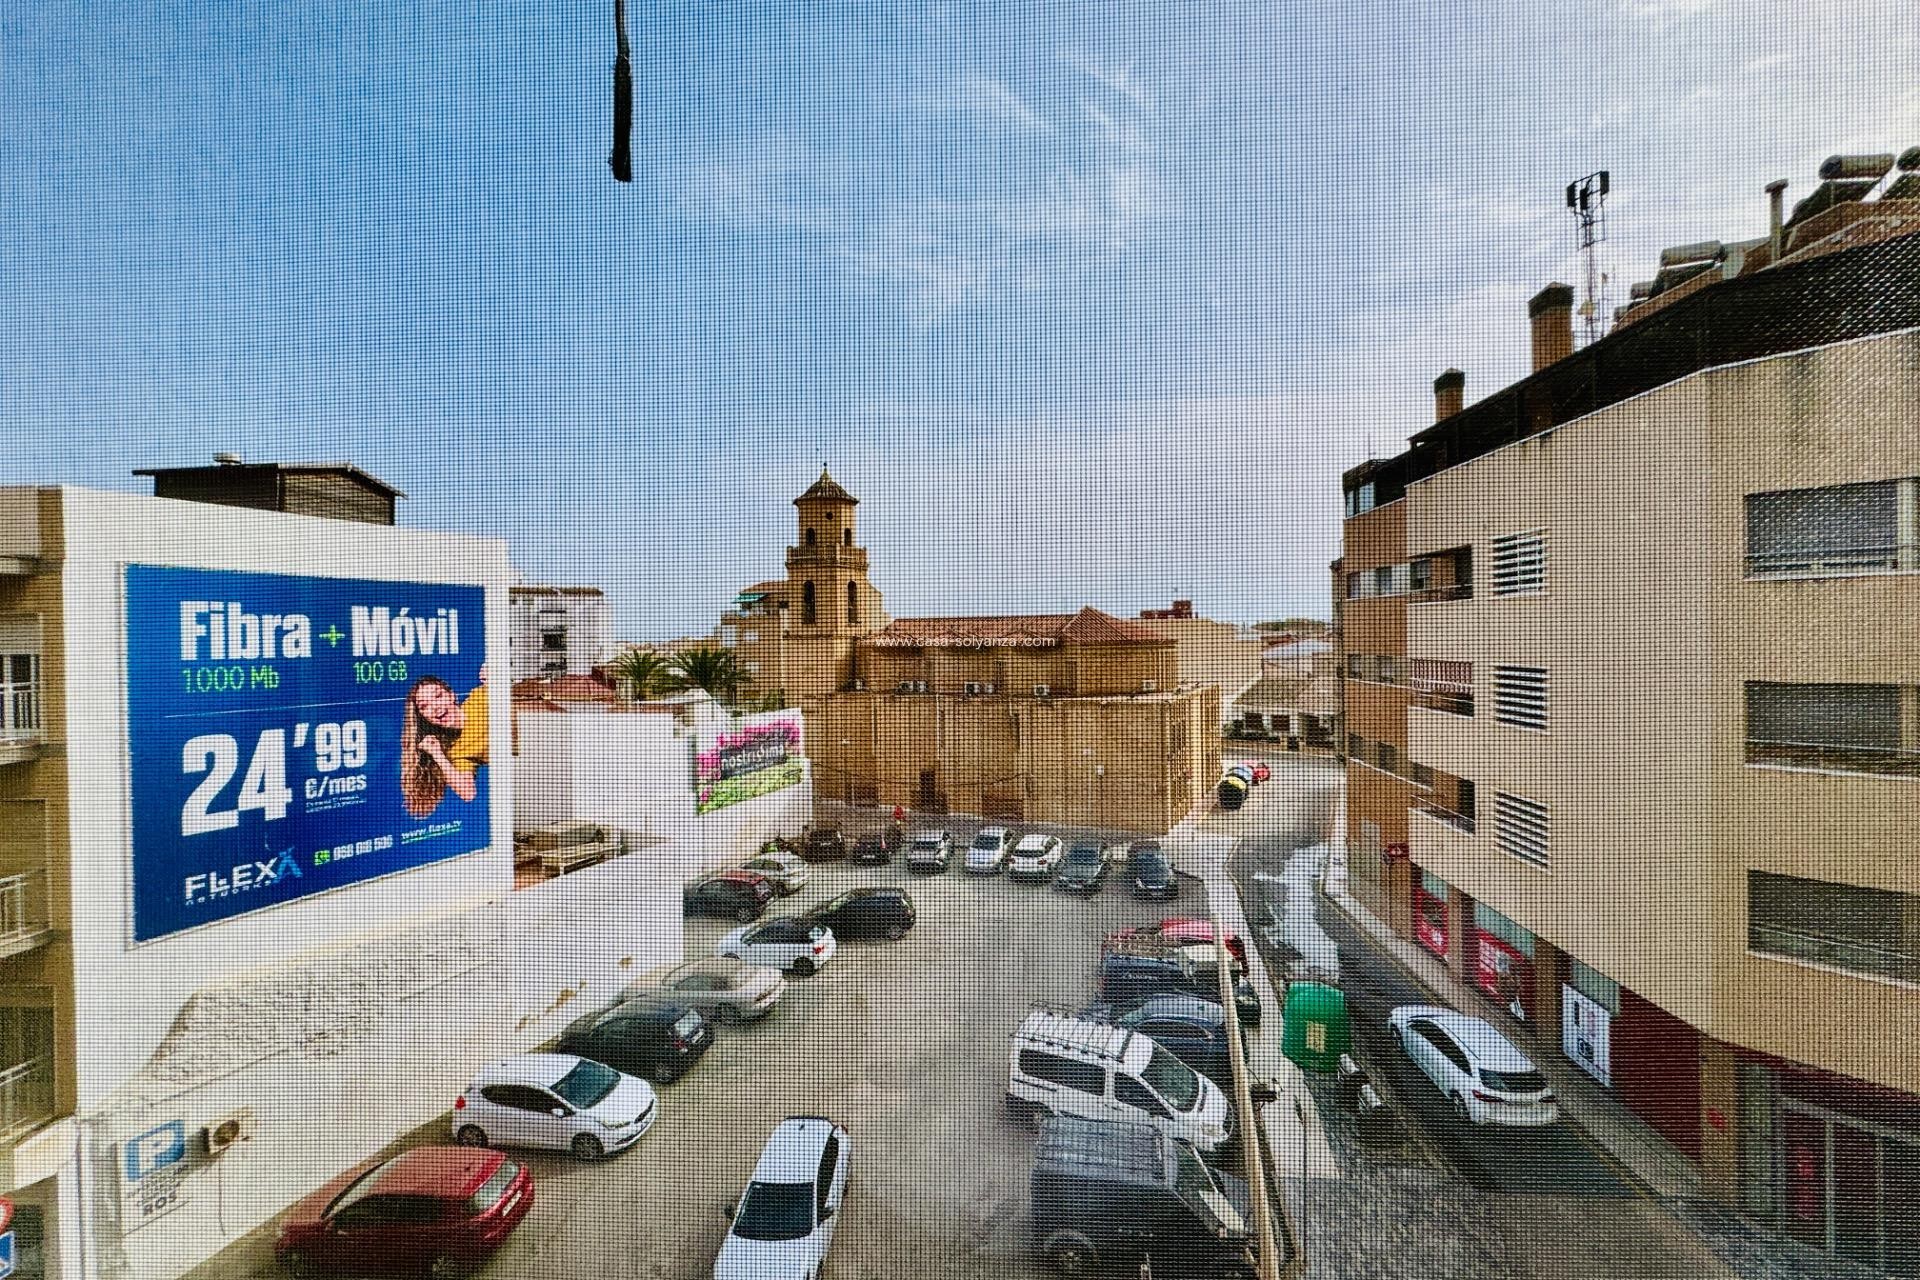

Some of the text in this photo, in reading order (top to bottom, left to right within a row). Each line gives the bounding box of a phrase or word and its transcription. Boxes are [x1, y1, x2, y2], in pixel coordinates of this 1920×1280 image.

[180, 600, 459, 660] Fibra + Móvil
[182, 664, 280, 693] 1.000 Mb
[353, 660, 408, 684] 100 GB
[305, 774, 367, 799] €/mes
[185, 853, 303, 900] FLEXA
[138, 1127, 174, 1175] P
